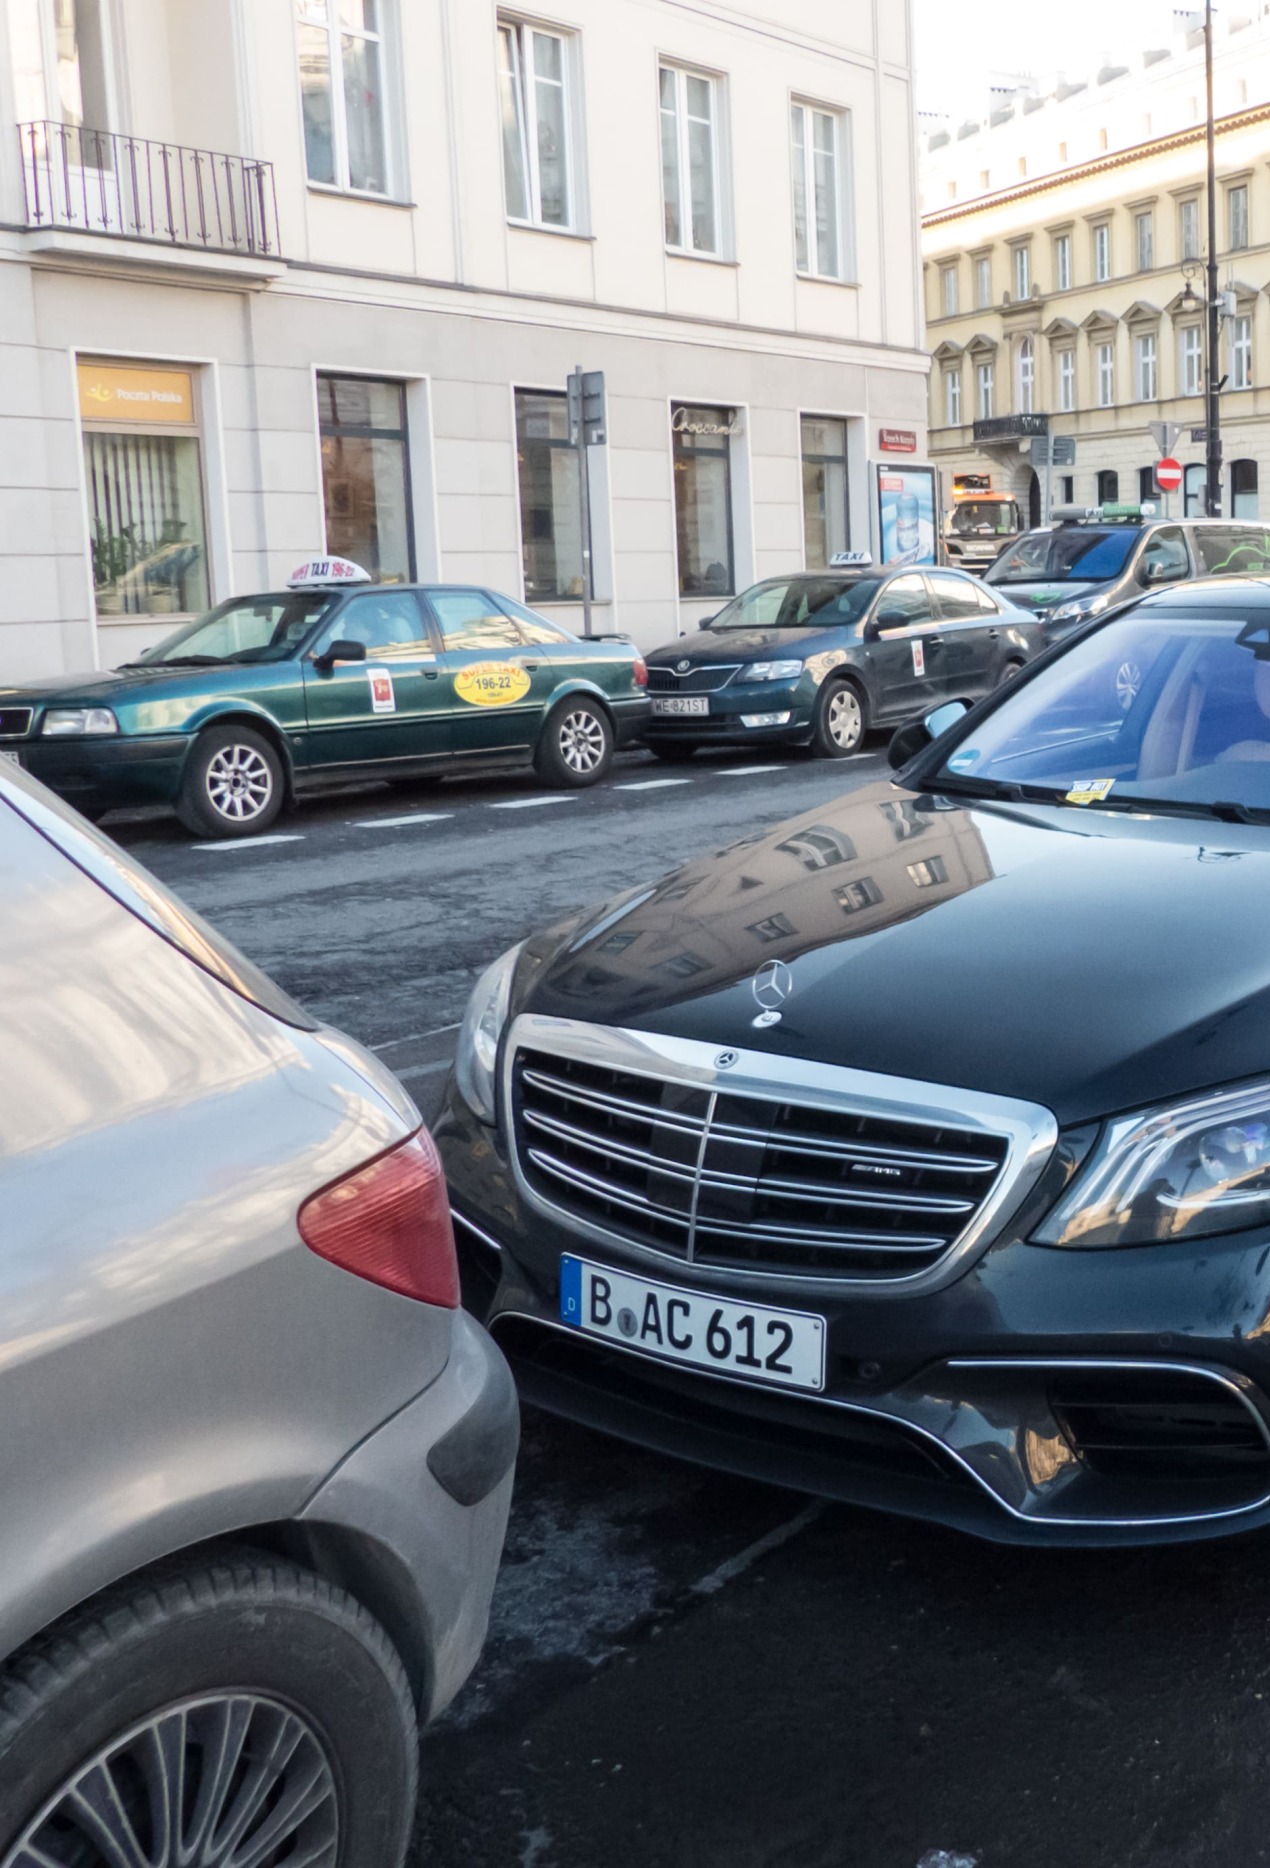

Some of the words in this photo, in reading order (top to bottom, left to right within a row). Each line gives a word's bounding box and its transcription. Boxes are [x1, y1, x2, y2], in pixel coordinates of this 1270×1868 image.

[116, 388, 150, 402] Poczta
[151, 390, 183, 403] Polska
[834, 552, 865, 561] TAXI
[311, 562, 330, 577] TAXI
[461, 663, 495, 681] SUPER
[499, 663, 521, 678] TAXI
[475, 676, 511, 690] 196-22
[672, 700, 706, 712] 821ST
[567, 1297, 576, 1312] D
[590, 1274, 613, 1327] B
[640, 1292, 693, 1351] AC
[706, 1308, 794, 1375] 612
